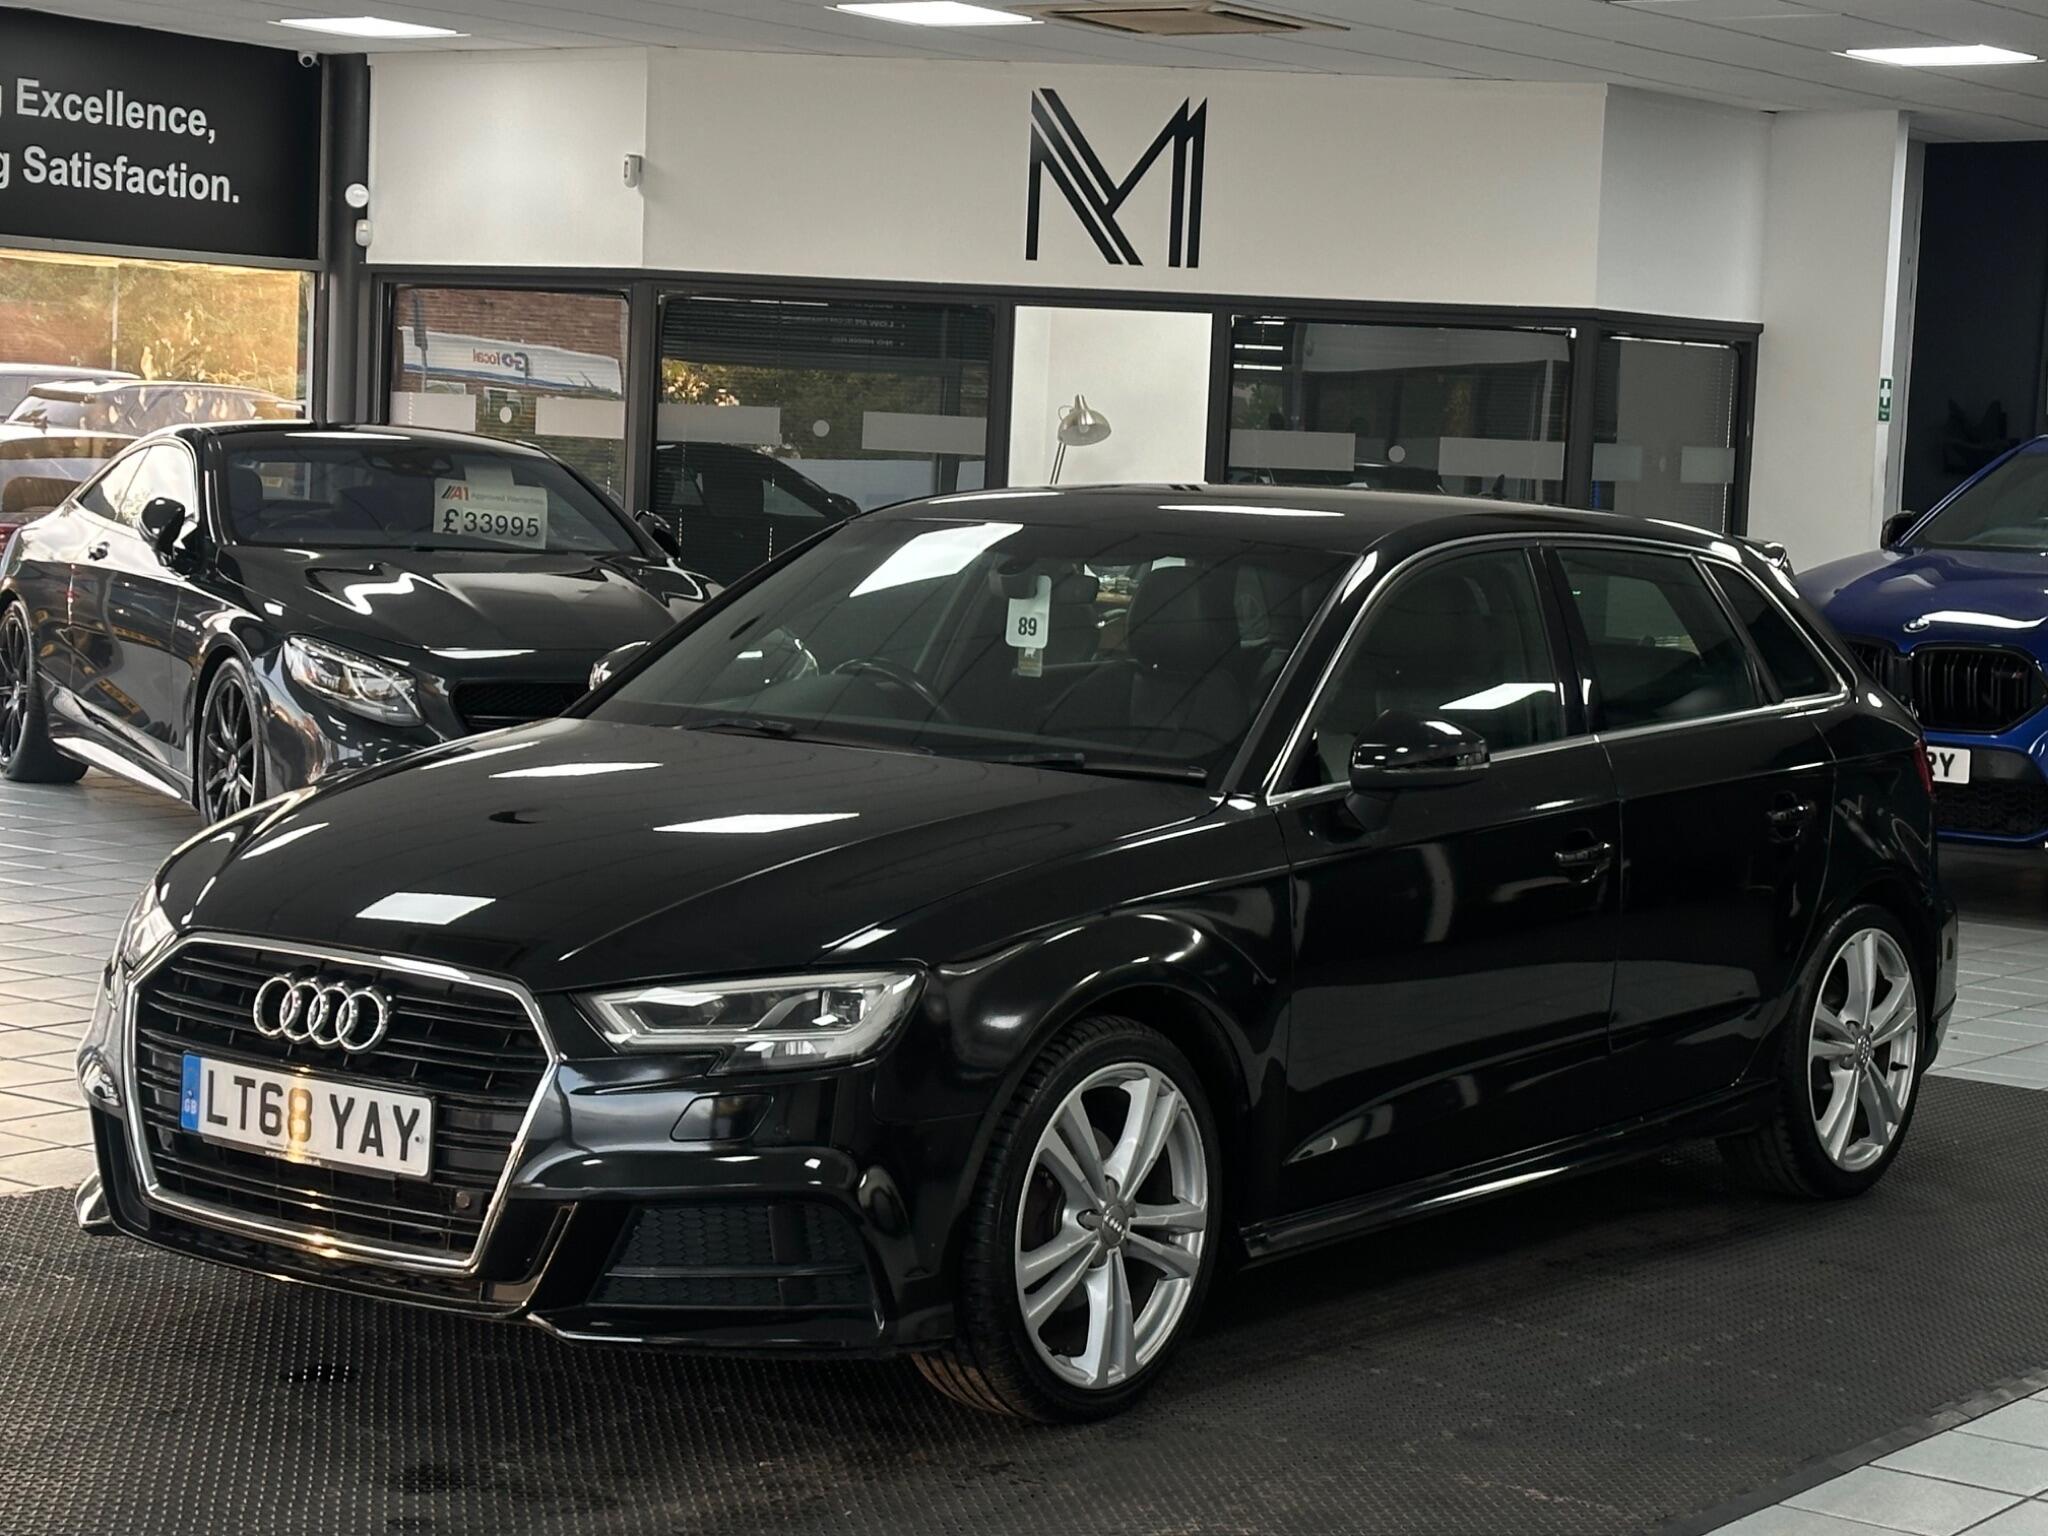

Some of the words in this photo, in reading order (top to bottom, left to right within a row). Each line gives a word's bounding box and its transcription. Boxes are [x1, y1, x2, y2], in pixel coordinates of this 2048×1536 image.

[16, 78, 215, 144] Excellence,
[23, 146, 239, 203] Satisfaction.
[442, 509, 539, 537] £33995
[1018, 617, 1037, 636] 89
[207, 1070, 313, 1142] LT68
[329, 1094, 420, 1161] YAY
